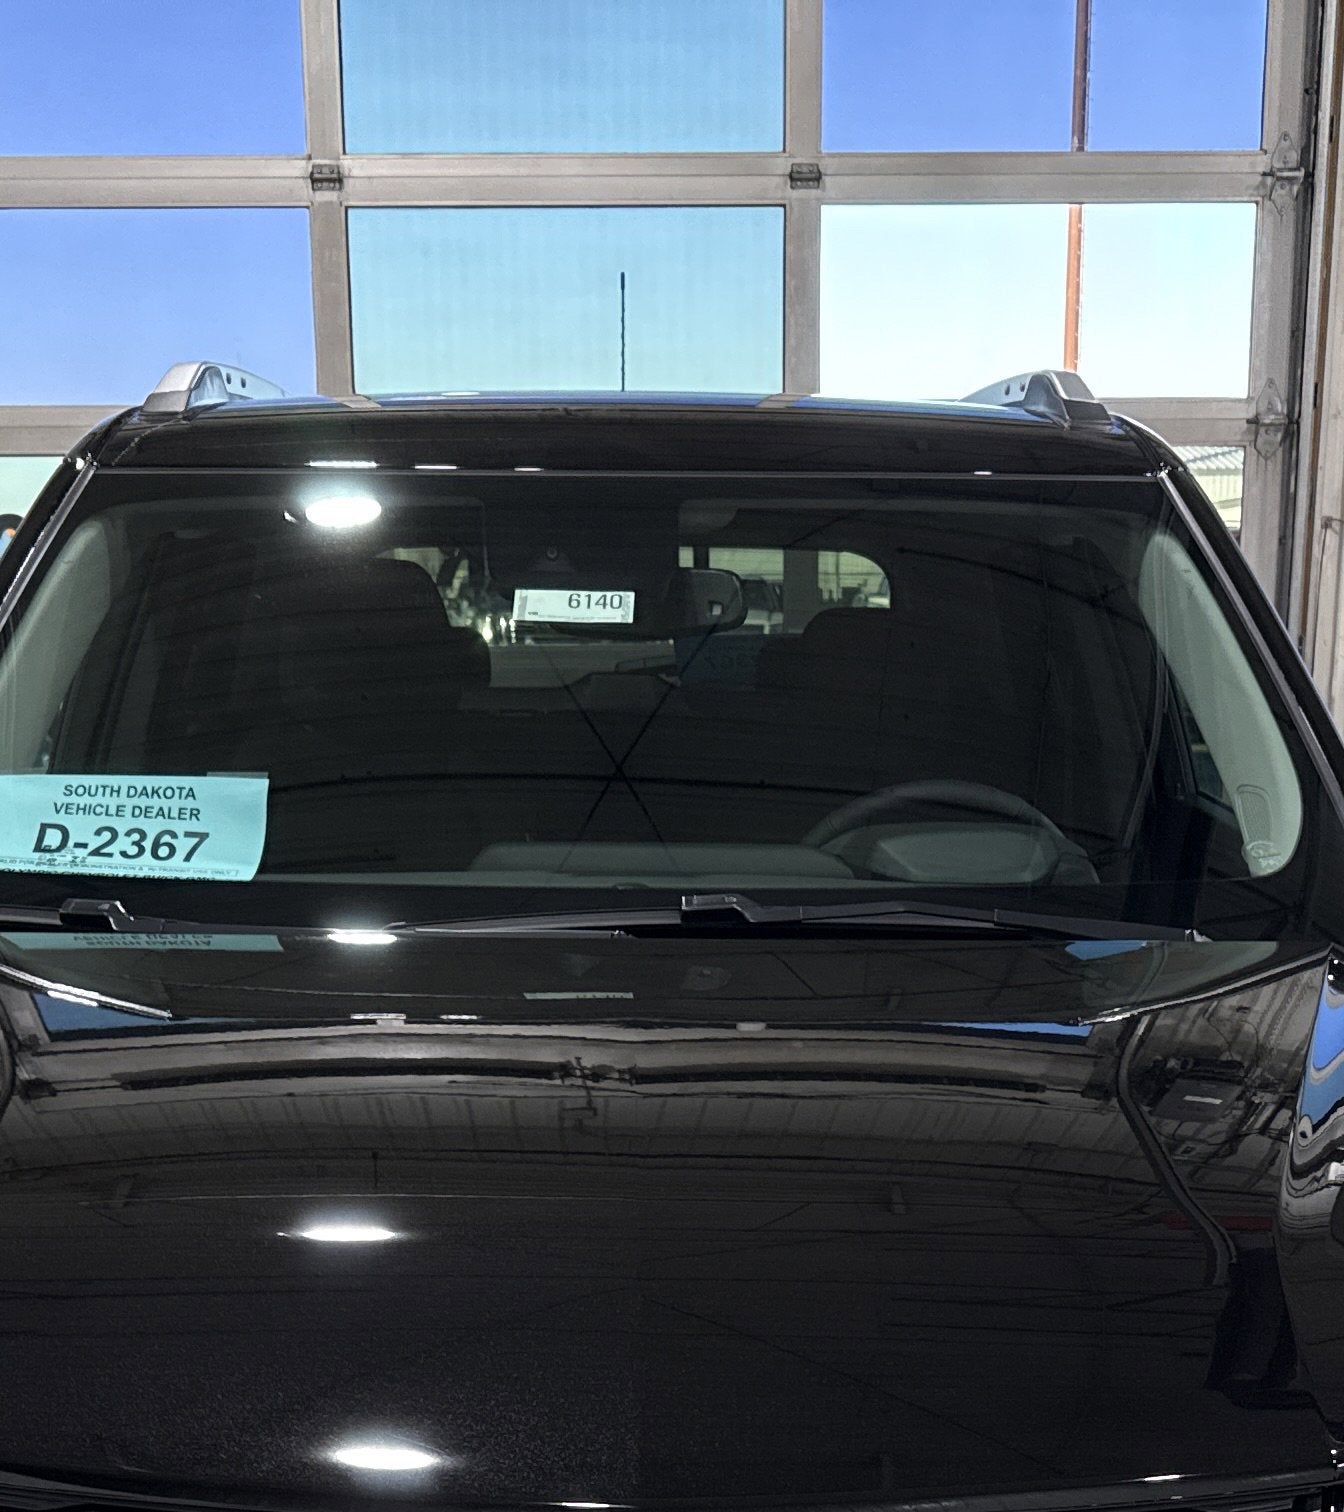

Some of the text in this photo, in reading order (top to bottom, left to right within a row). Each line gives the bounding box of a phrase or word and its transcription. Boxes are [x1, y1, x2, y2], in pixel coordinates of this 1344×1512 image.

[568, 593, 623, 609] 6140
[62, 784, 197, 800] SOUTH DAKOTA
[53, 802, 201, 821] VEHICLE DEALER
[32, 822, 209, 863] D-2367
